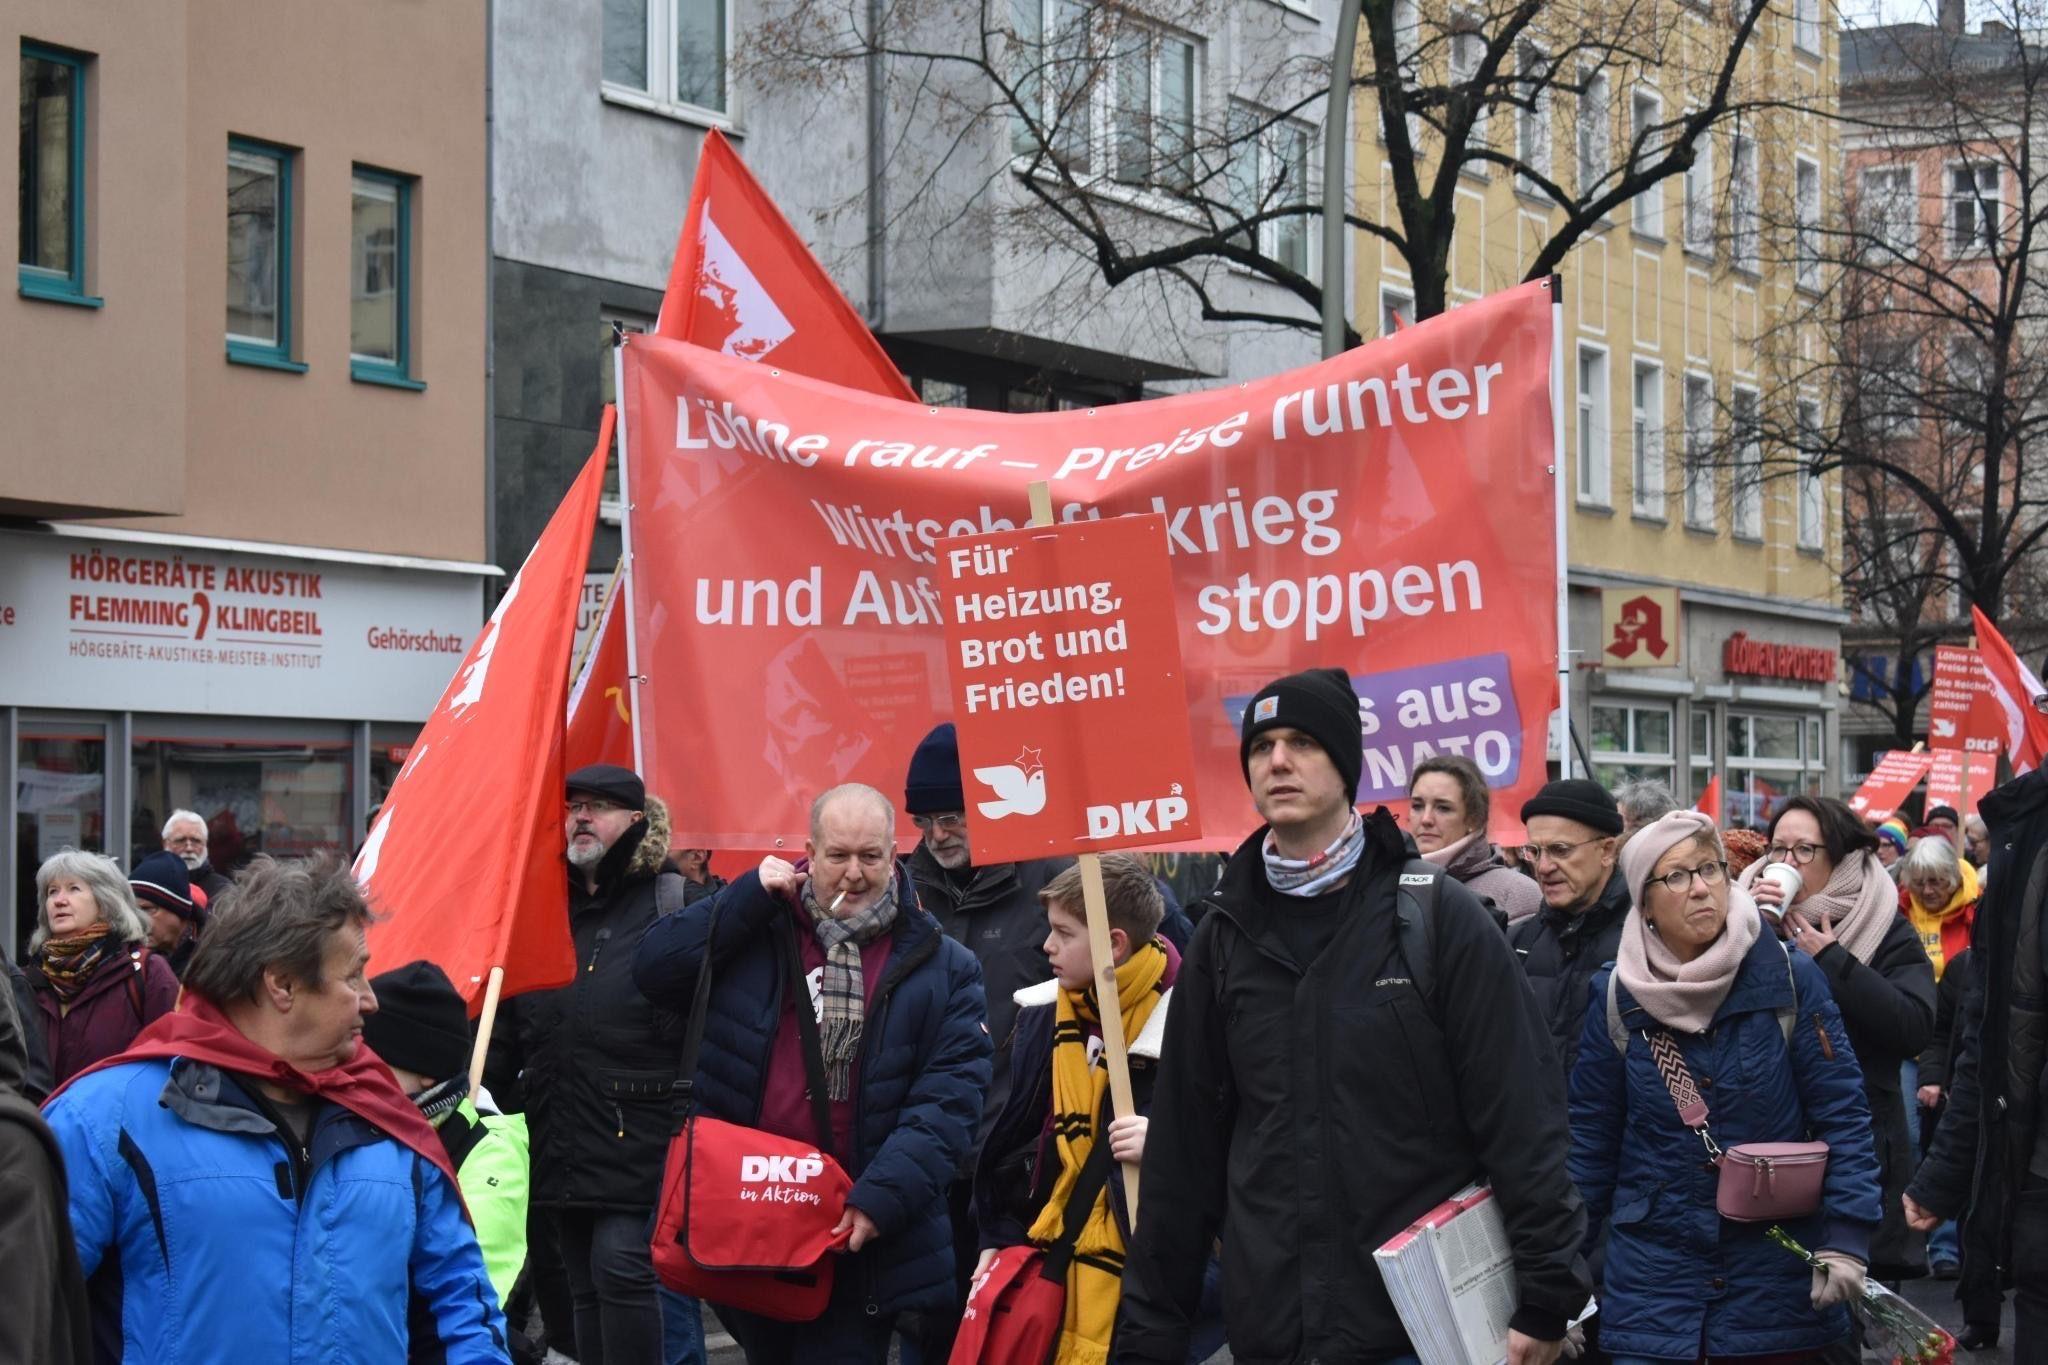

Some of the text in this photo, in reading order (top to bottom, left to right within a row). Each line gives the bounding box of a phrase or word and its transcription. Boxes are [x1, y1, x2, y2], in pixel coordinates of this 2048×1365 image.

[676, 396, 829, 467] Löhne
[844, 438, 998, 470] rauf
[1053, 411, 1249, 481] Preise
[1272, 362, 1504, 440] runter
[70, 549, 322, 599] HÖRGERÄTE AKUSTIK
[950, 544, 1014, 579] Für
[696, 566, 822, 627] und
[1197, 557, 1483, 641] stoppen
[955, 582, 1122, 624] Heizung,
[70, 594, 322, 636] FLEMMING KLINGBEIL
[70, 639, 323, 669] HÖRGERÄTE-AKUSTIKER-MEISTER-INSTITUT
[367, 626, 463, 653] Gehörschutz
[961, 619, 1128, 669] Brot und
[1936, 662, 1968, 673] Preise
[1937, 651, 1968, 663] Löhne
[966, 667, 1126, 714] Frieden!
[1934, 688, 1973, 700] müssen
[1935, 678, 1952, 688] Die
[1396, 677, 1502, 729] aus
[1933, 701, 1970, 713] zahlen!
[1965, 738, 1998, 752] DKP
[1932, 764, 1988, 775] Wirtscafts-
[1930, 783, 1973, 793] stoppe!
[1087, 796, 1189, 840] DKP
[741, 1155, 824, 1184] DKP
[740, 1185, 821, 1206] in Aktion
